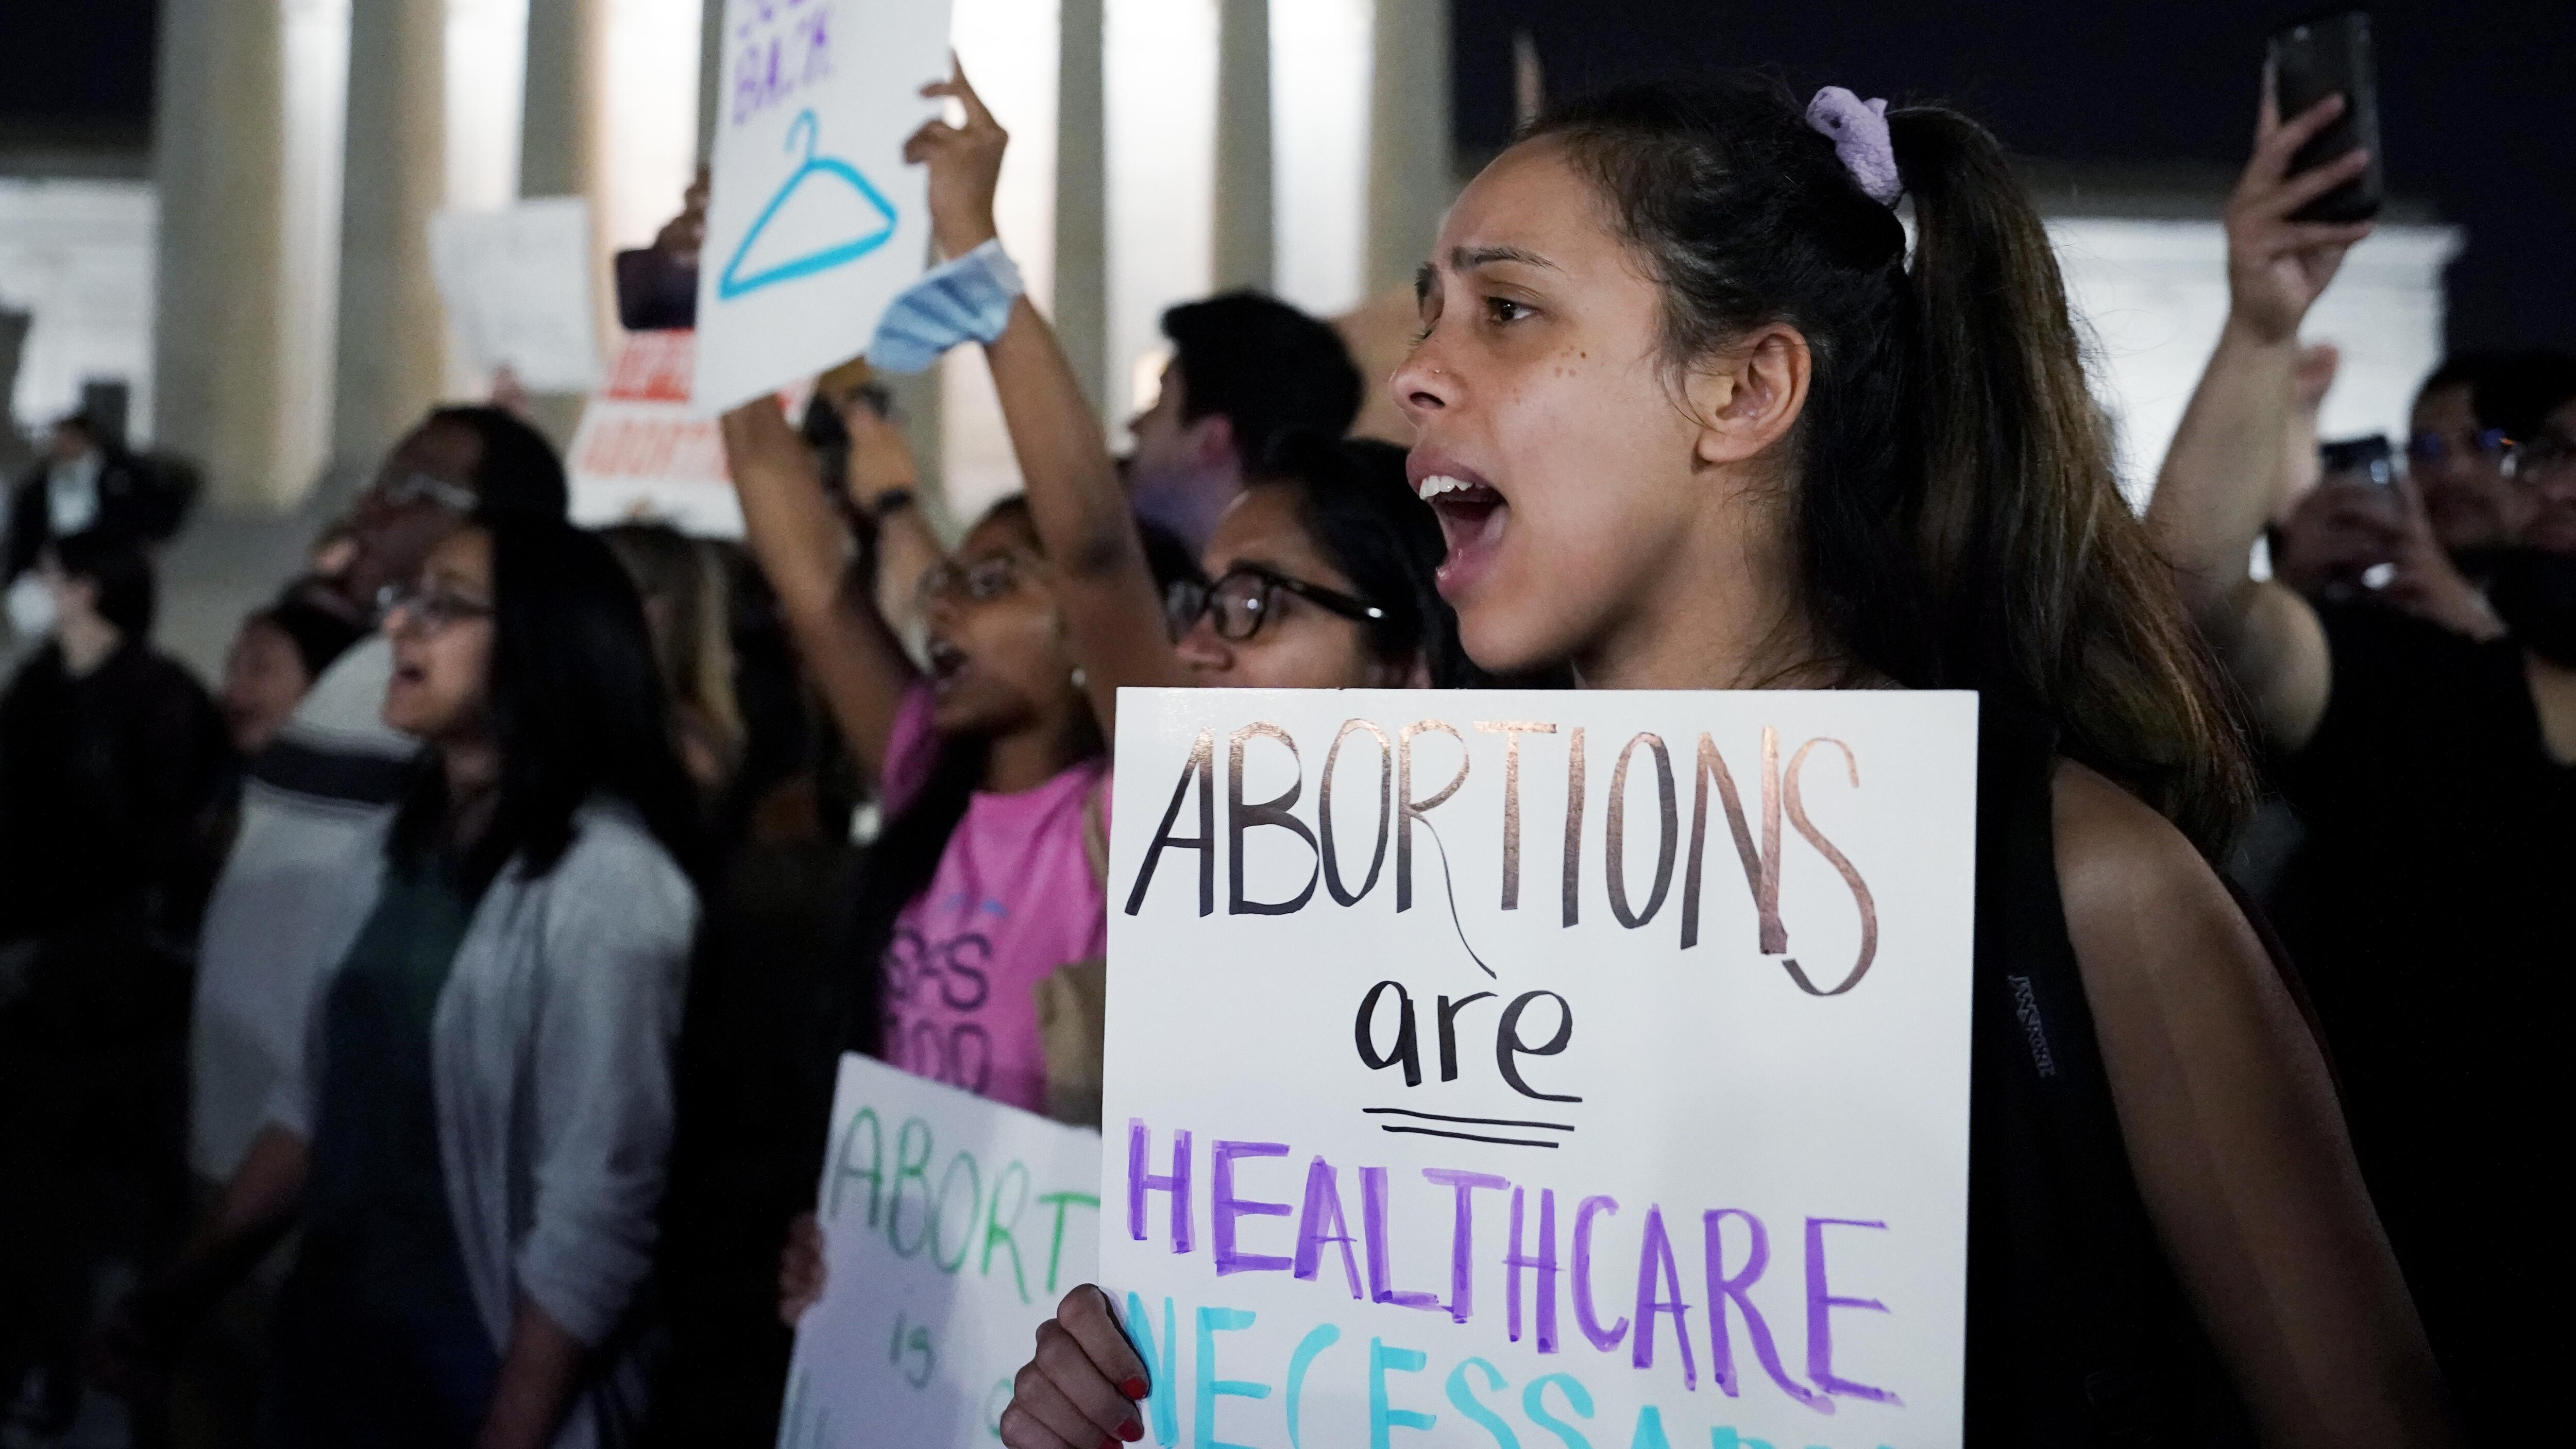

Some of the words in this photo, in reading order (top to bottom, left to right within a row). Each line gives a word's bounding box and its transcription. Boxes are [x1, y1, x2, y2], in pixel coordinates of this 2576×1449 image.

[1125, 718, 1878, 995] ABORTIONS
[1355, 980, 1582, 1102] are
[1125, 1291, 1896, 1449] NECESS
[1127, 1117, 1906, 1416] HEALTHCARE
